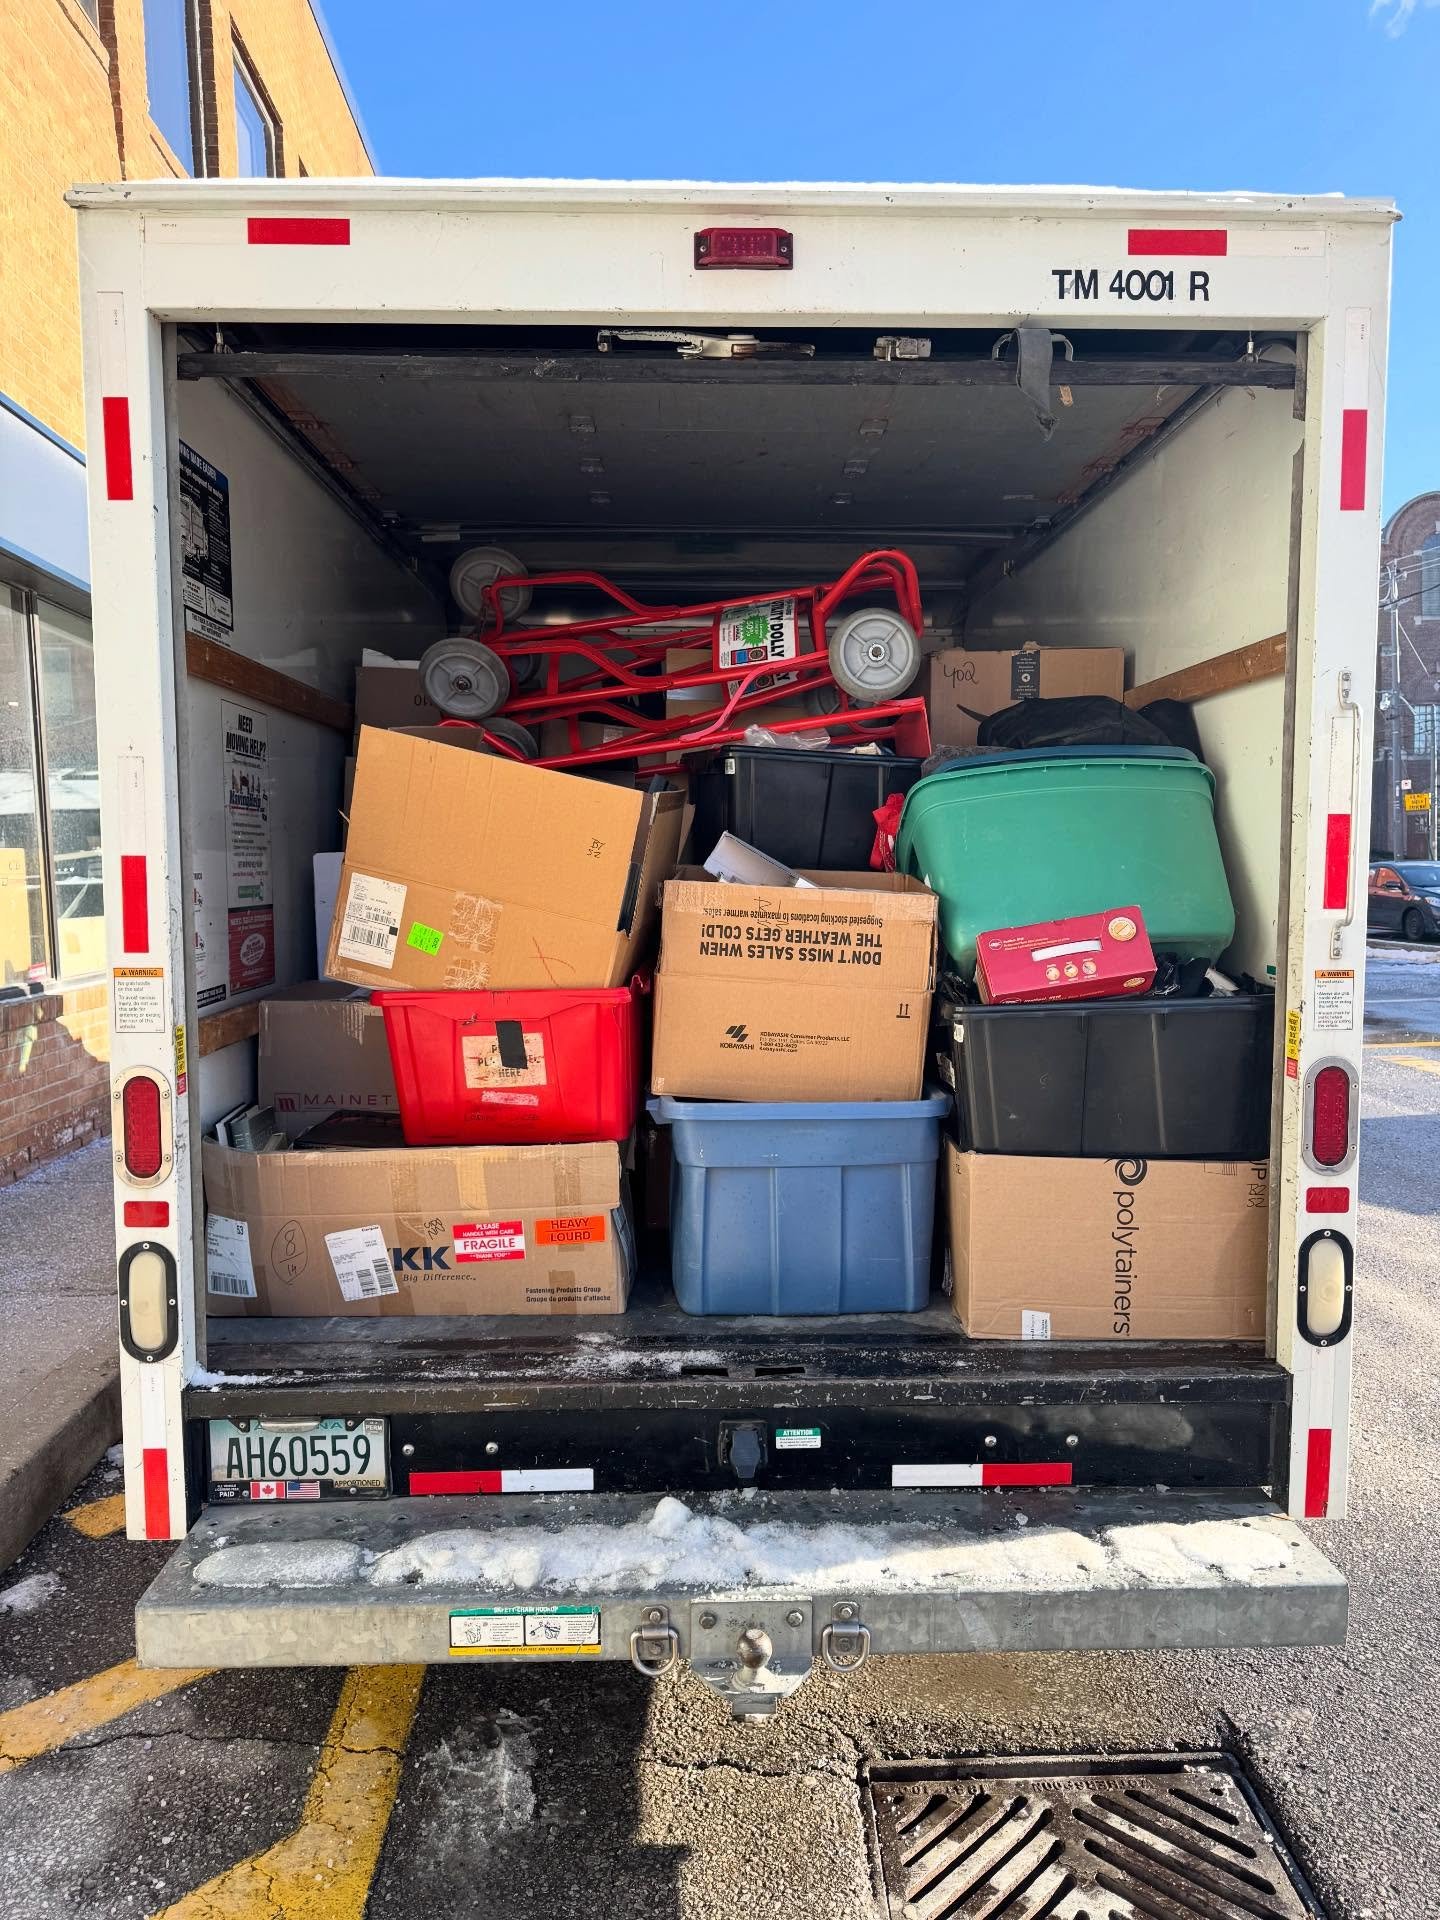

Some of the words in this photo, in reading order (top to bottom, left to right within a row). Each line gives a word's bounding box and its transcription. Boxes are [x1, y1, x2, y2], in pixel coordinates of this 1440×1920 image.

[1051, 269, 1099, 299] TM
[1109, 269, 1174, 301] 4001
[1189, 270, 1210, 301] R
[770, 623, 785, 658] DOLLY
[238, 713, 253, 734] NEED
[226, 732, 249, 754] MOVING
[249, 738, 267, 759] HELP?
[722, 907, 749, 919] warmer
[750, 908, 782, 920] maximize
[789, 911, 819, 924] locations
[820, 912, 848, 925] stocking
[850, 914, 883, 928] Suggested
[701, 923, 742, 939] COLD!
[746, 926, 781, 942] GETS
[785, 928, 852, 946] WEATHER
[856, 932, 883, 948] THE
[699, 941, 743, 957] WHEN
[747, 944, 794, 961] SALES
[798, 947, 834, 963] MISS
[837, 950, 882, 966] DON'T
[720, 1042, 754, 1050] KOBAYASHI
[236, 1225, 244, 1235] 53
[475, 1223, 500, 1231] PLEASE
[551, 1218, 590, 1229] HEAVY
[463, 1238, 516, 1250] FRAGILE
[550, 1231, 591, 1242] LOURD
[388, 1246, 452, 1271] KK
[1112, 1190, 1139, 1334] polytainers
[403, 1274, 418, 1283] Big
[365, 1424, 383, 1432] PERM
[226, 1434, 371, 1478] AH60559
[334, 1479, 381, 1487] APPORTIONED
